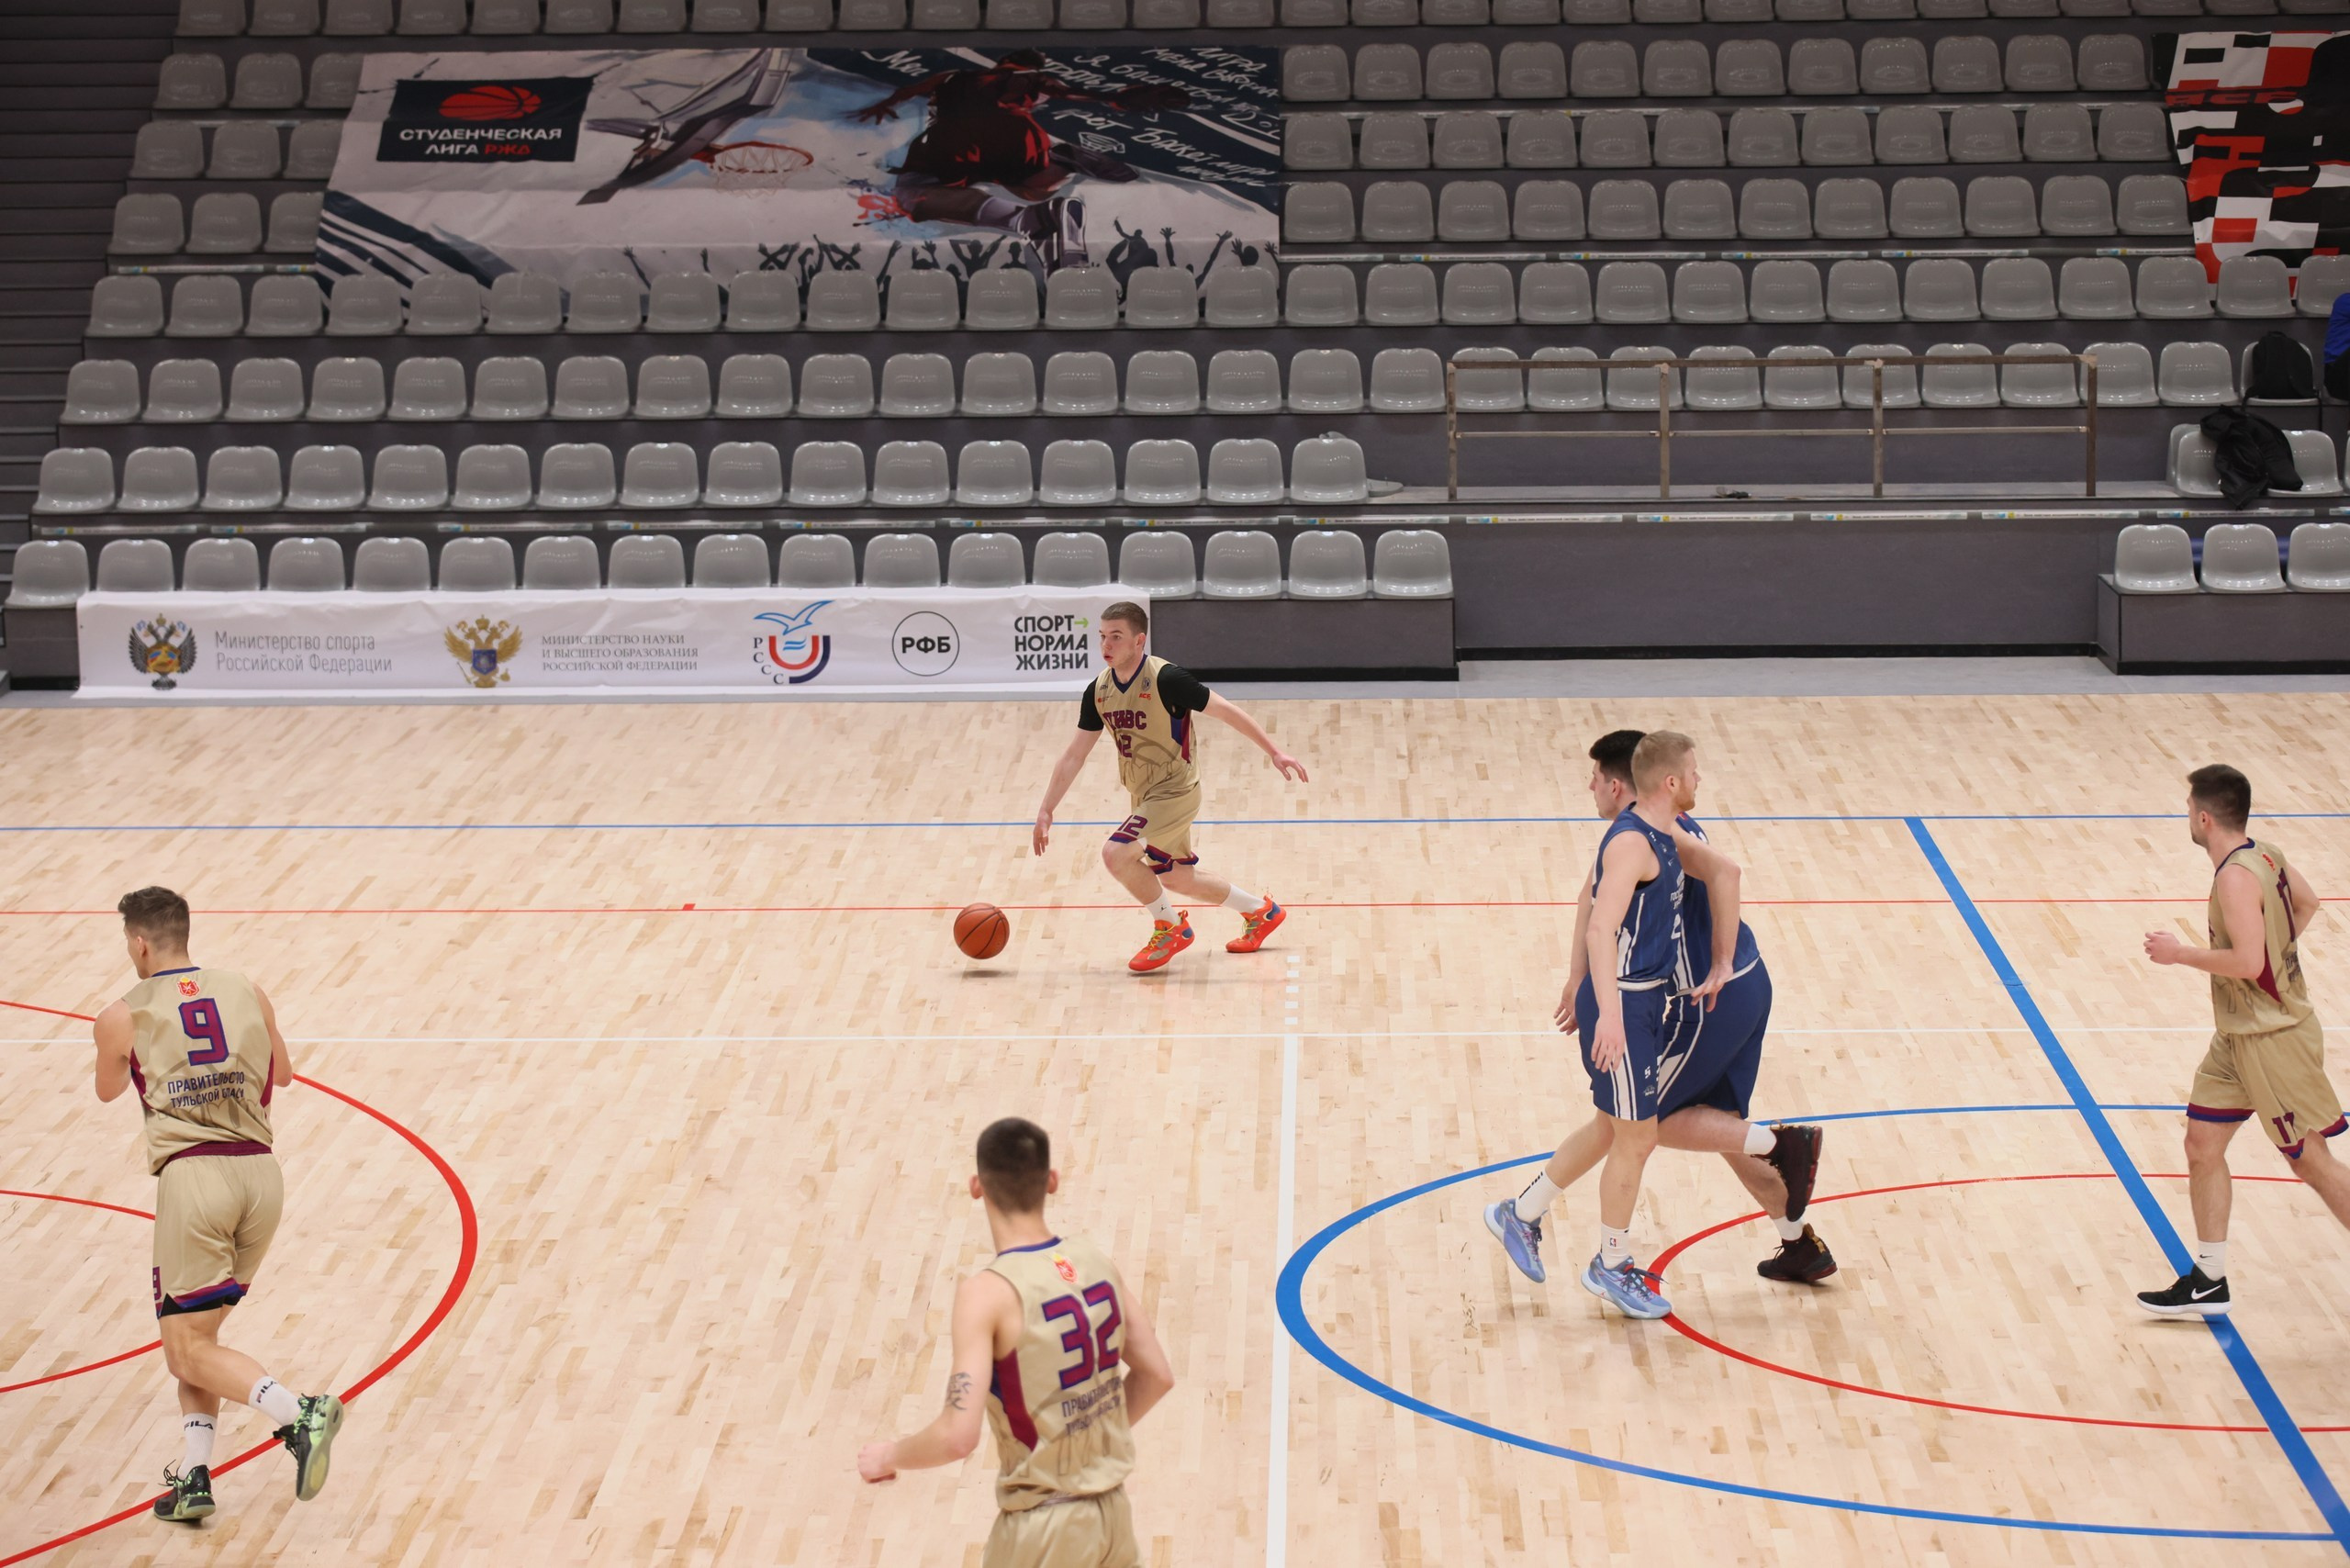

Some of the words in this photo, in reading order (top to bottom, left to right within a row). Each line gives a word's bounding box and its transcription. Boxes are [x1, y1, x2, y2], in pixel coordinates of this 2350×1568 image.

[398, 128, 563, 141] СТУДЕНЧЕСКАЯ
[425, 143, 479, 155] ЛИГА
[484, 144, 531, 155] РЖД
[1013, 614, 1074, 633] СПОРТ
[215, 630, 320, 651] Министерство
[326, 634, 375, 651] спорта
[542, 634, 640, 645] МИНИСТЕРСТВО
[643, 634, 685, 644] НАУКИ
[901, 636, 951, 655] РФБ
[1014, 634, 1089, 652] НОРМА
[542, 648, 551, 658] И
[554, 648, 611, 658] ВЫСШЕГО
[613, 647, 699, 658] ОБРАЗОВАНИЯ
[217, 651, 304, 672] Российской
[309, 653, 392, 674] Федерации
[543, 659, 624, 671] РОССИЙСКОЙ
[626, 660, 698, 672] ФЕДЕРАЦИИ
[1015, 653, 1089, 671] ЖИЗНИ
[1118, 814, 1148, 836] 12
[178, 998, 229, 1067] 9
[171, 1089, 219, 1109] ТУЛЬСКОЙ
[1041, 1280, 1122, 1391] 32
[184, 1420, 214, 1431] FILA
